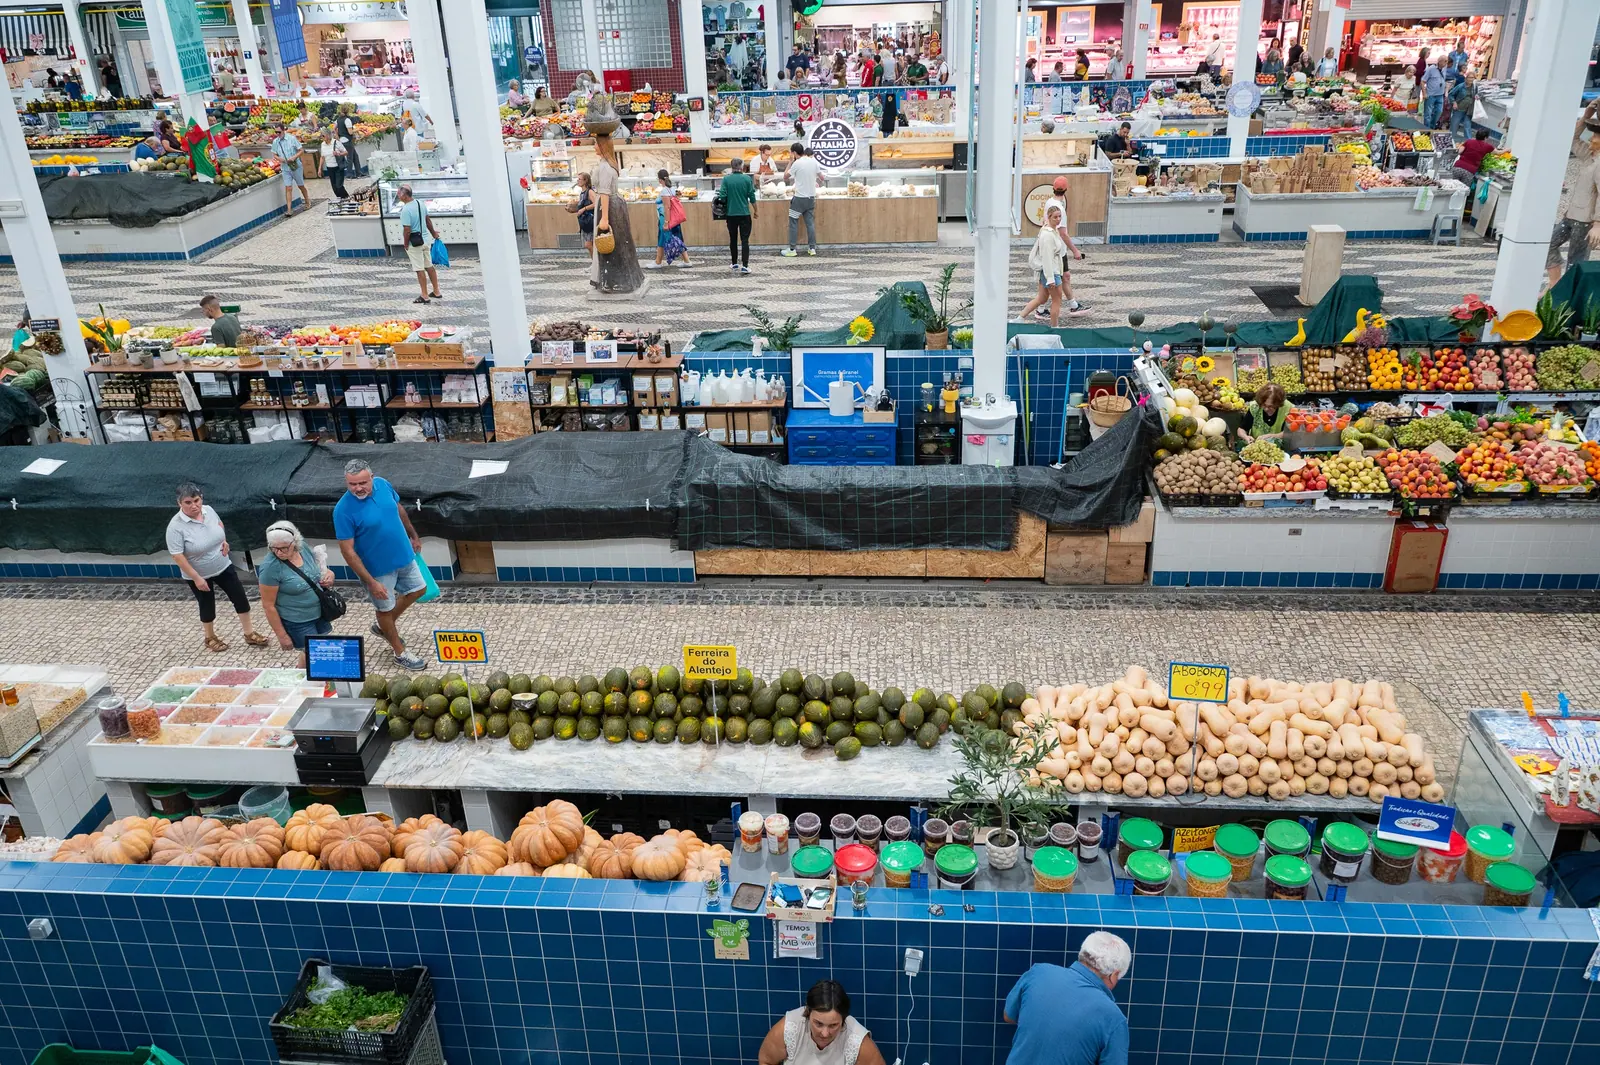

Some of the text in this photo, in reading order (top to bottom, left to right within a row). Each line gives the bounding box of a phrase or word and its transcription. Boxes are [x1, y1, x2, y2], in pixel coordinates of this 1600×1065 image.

[305, 3, 359, 13] TALHO
[820, 121, 843, 132] PÃO
[811, 138, 855, 149] FARALHÃO
[438, 634, 478, 643] MELÃO
[443, 646, 479, 660] 0.99
[688, 648, 729, 657] Ferreira
[702, 657, 716, 666] do
[688, 665, 732, 676] Alentejo
[785, 924, 811, 932] TEMOS
[781, 939, 799, 947] MB
